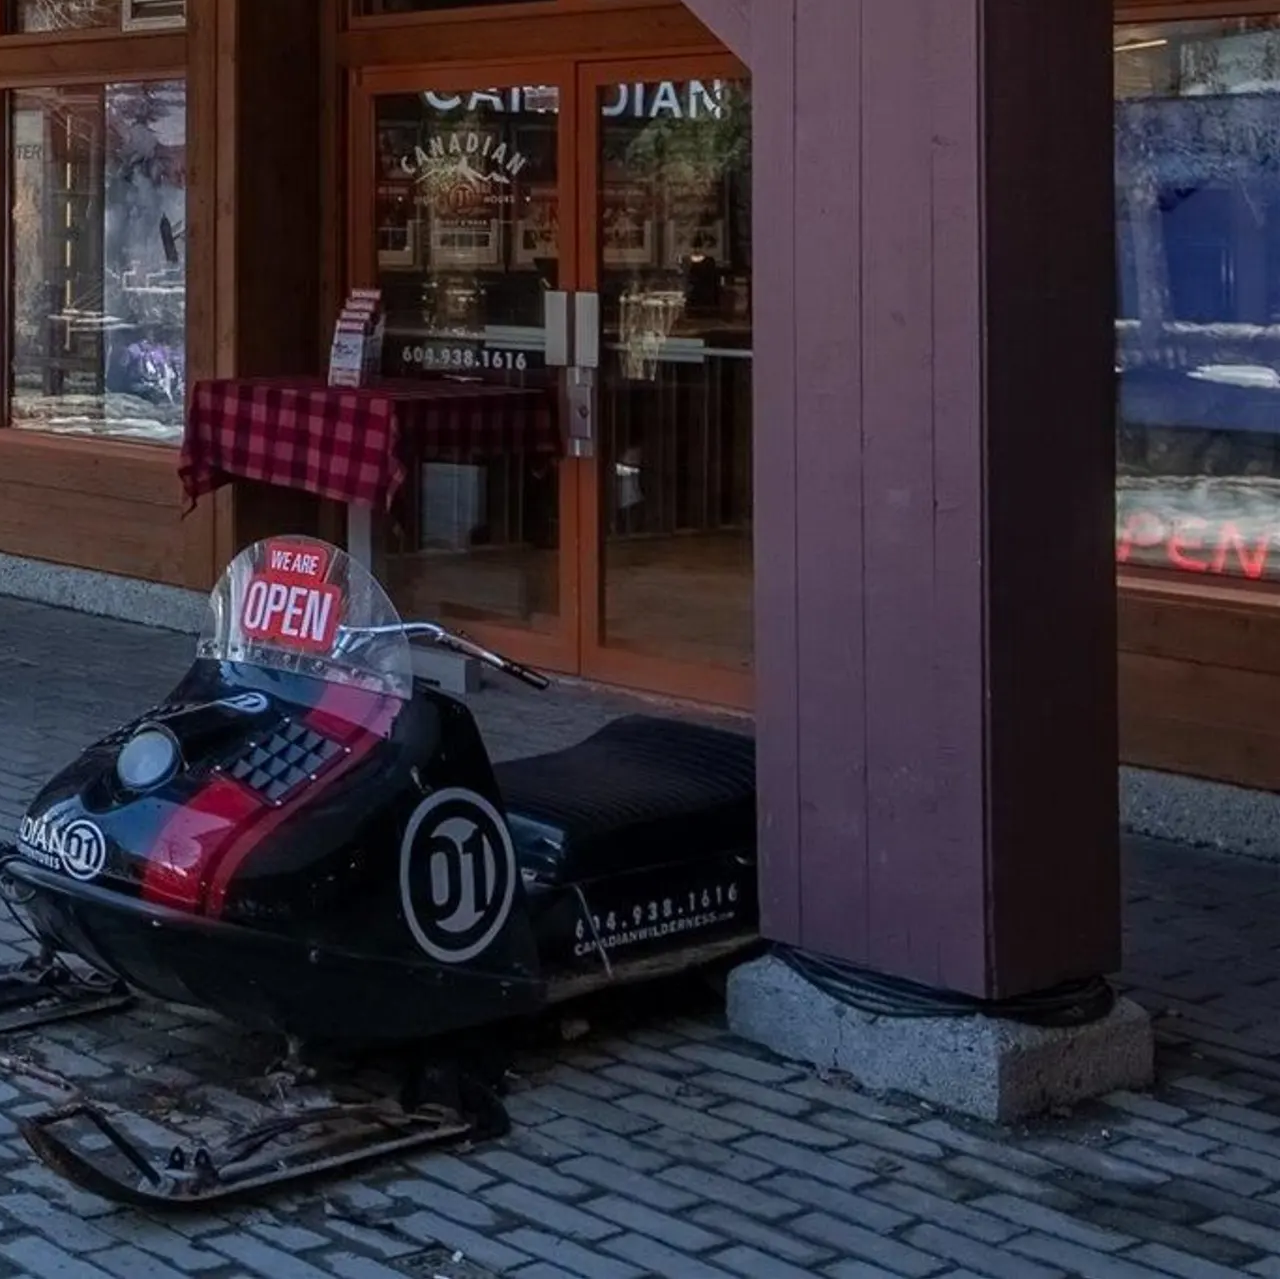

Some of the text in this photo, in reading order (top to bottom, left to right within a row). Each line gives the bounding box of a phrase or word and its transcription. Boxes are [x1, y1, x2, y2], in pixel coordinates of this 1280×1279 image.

[401, 132, 527, 176] CANADIAN
[402, 345, 527, 370] 604.938.1616
[271, 550, 320, 576] WE ARE
[244, 580, 333, 642] OPEN
